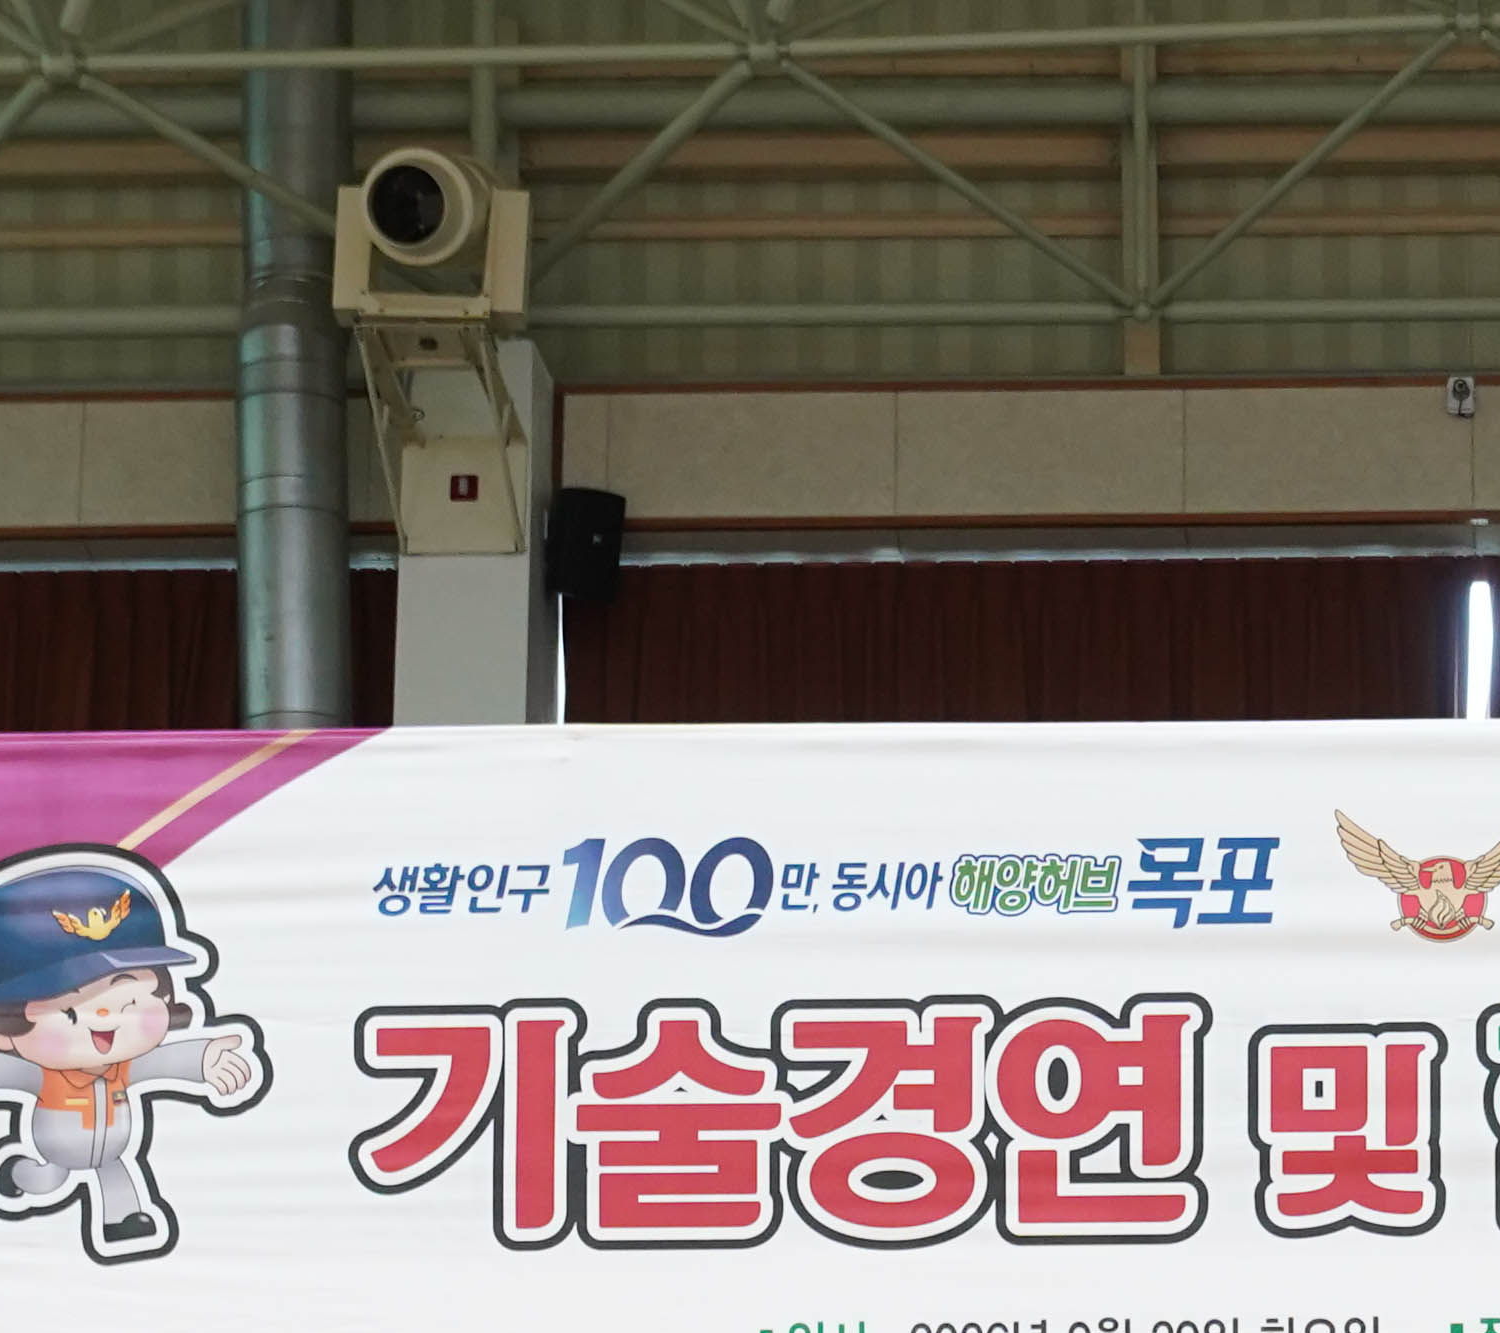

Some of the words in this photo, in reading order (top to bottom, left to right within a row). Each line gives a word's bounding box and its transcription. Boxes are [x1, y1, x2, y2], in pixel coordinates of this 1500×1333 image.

[373, 863, 551, 916] 생활인구
[831, 862, 943, 912] 동시아
[950, 854, 1122, 915] 해양허브
[1127, 837, 1280, 928] 목포
[355, 1003, 1203, 1243] 기술경연
[1265, 1015, 1437, 1232] 및
